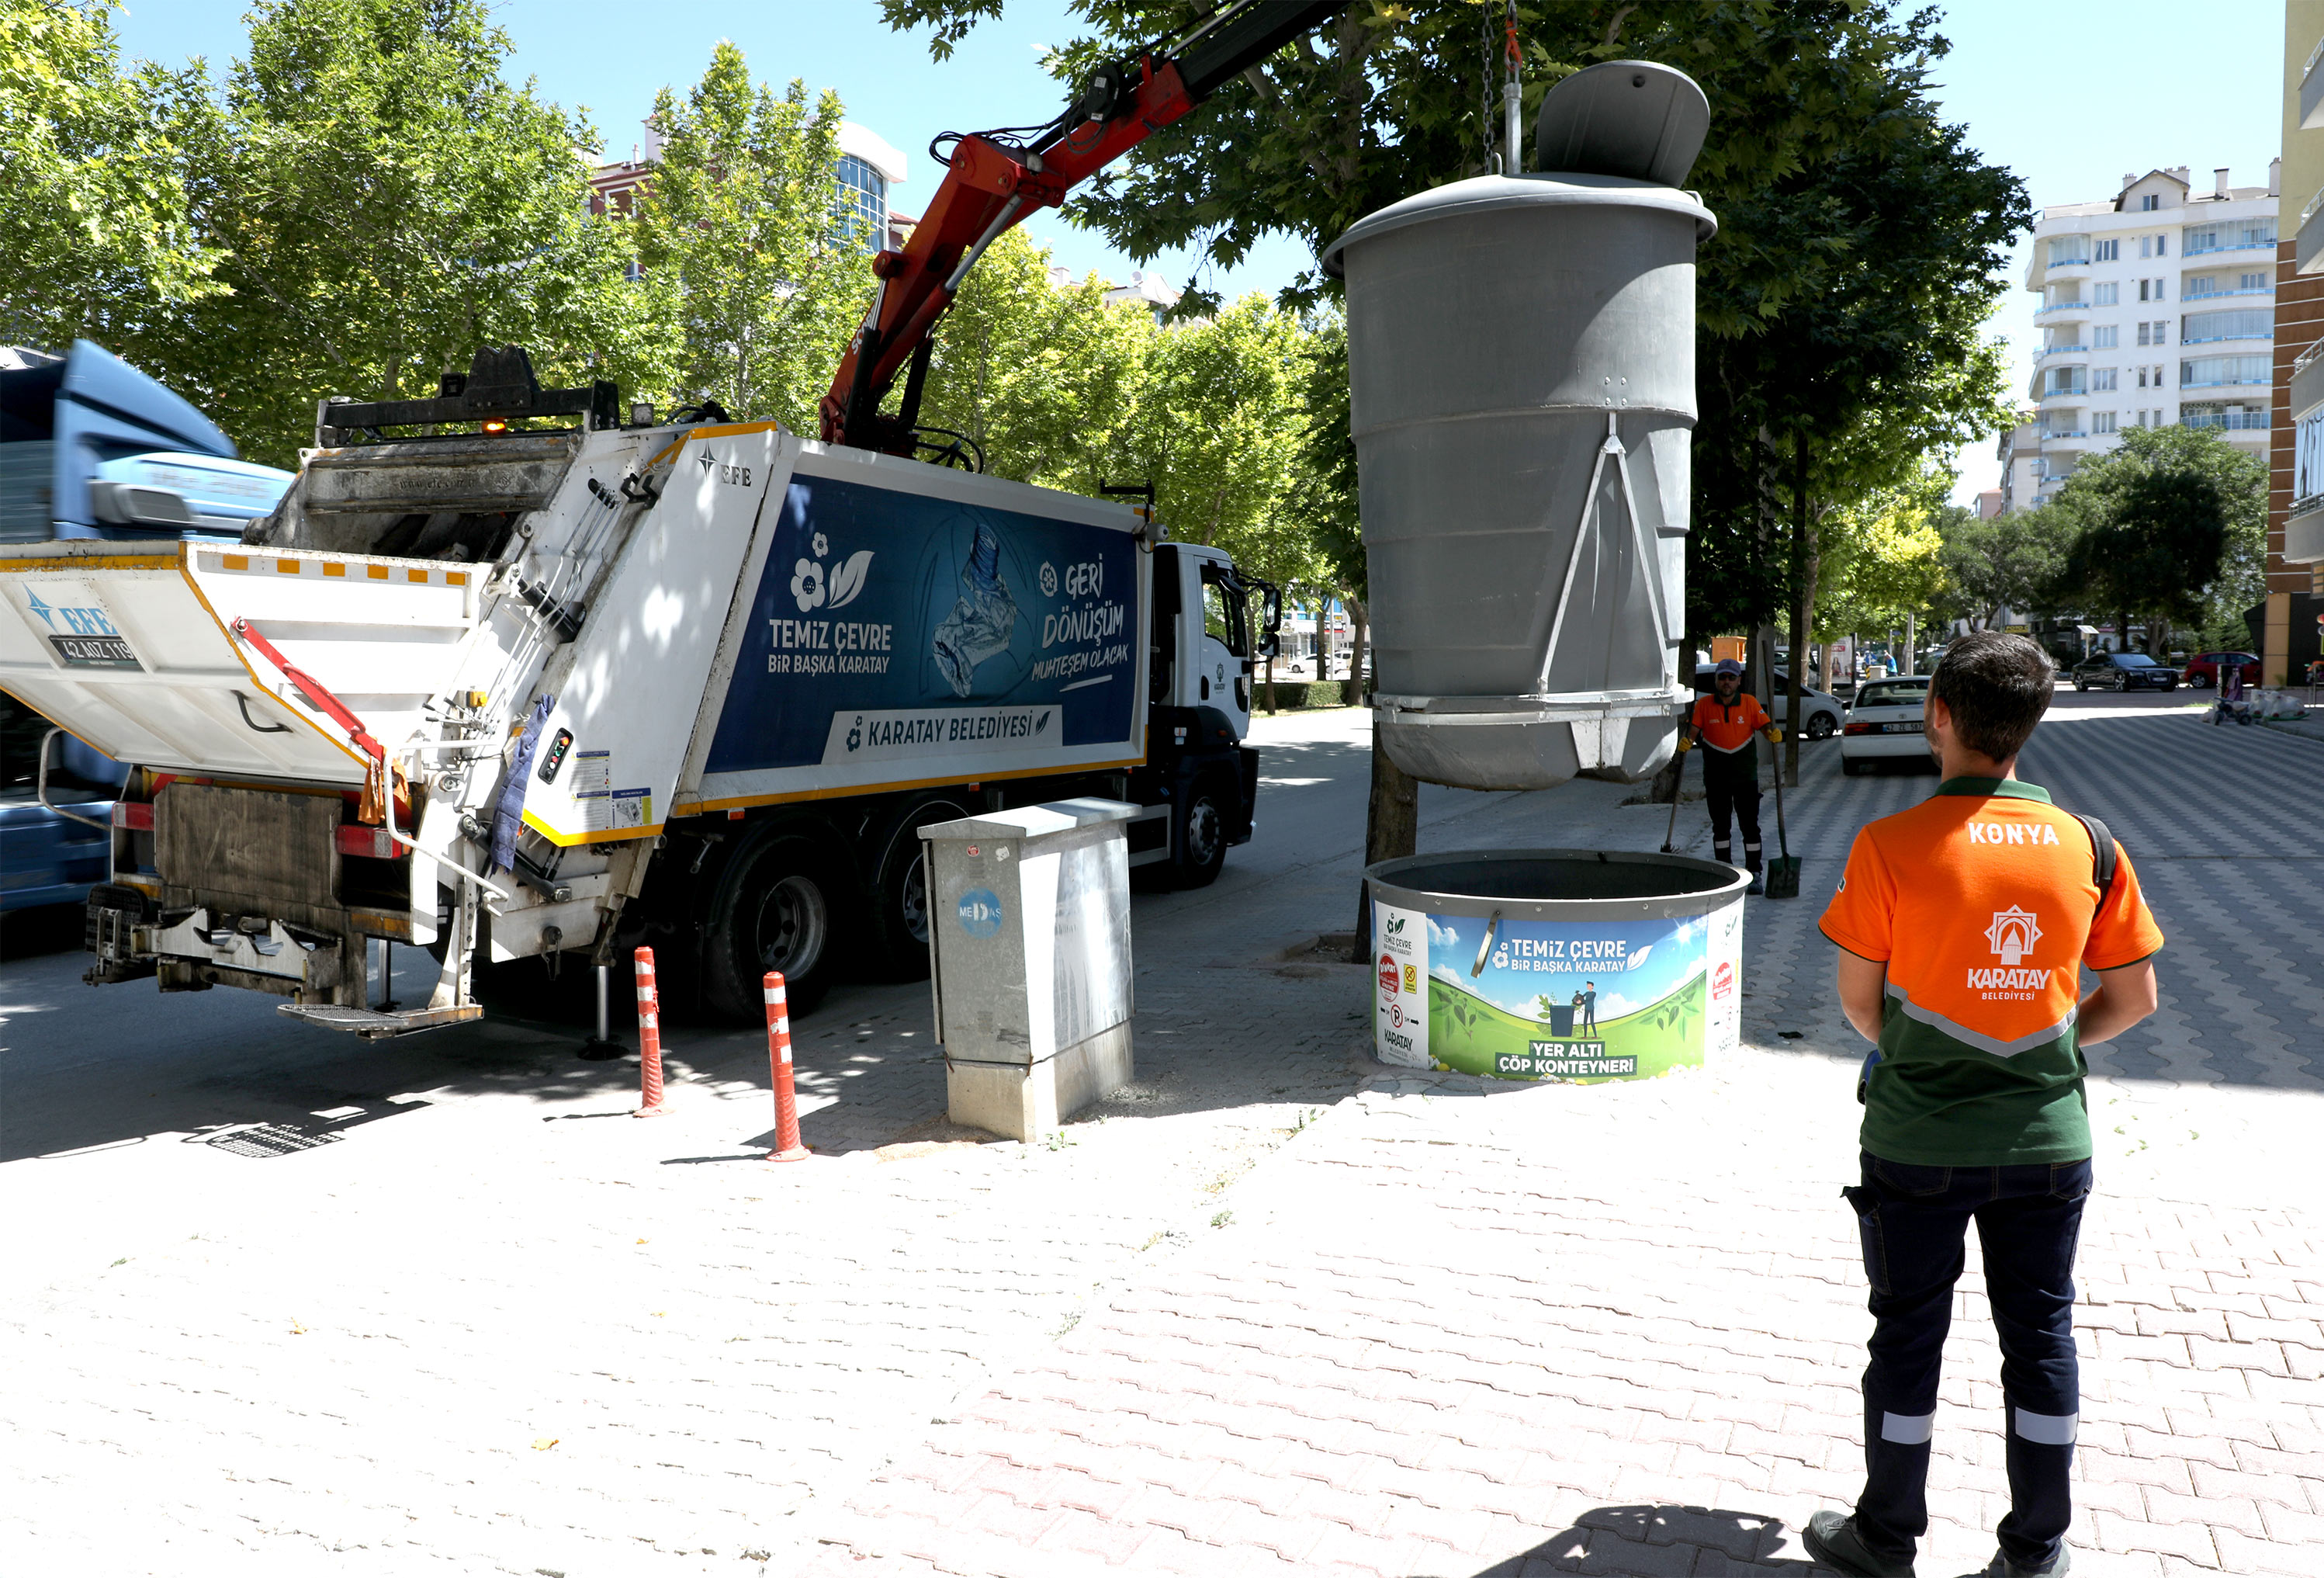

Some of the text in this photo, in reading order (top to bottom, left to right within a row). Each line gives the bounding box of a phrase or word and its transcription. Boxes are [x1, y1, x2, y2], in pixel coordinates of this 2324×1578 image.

[720, 464, 752, 487] EFE
[1065, 553, 1103, 600] GERİ
[58, 608, 119, 634] EFE
[1042, 600, 1124, 649] DÖNÜŞÜM
[834, 622, 892, 655] ÇEVRE
[106, 642, 135, 659] 119
[1031, 643, 1129, 681] MUHTEŞEM OLACAK
[794, 655, 836, 677] BAŞKA
[838, 656, 890, 674] KARATAY
[868, 709, 1033, 746] KARATAY BELEDİYESİ
[1968, 822, 2060, 845] KONYA
[1570, 940, 1626, 962] ÇEVRE
[1533, 960, 1573, 974] BAŞKA
[1575, 961, 1626, 973] KARATAY
[1966, 968, 2051, 990] KARATAY
[1981, 990, 2035, 1001] BELEDİYESİ
[1384, 1028, 1413, 1052] KARATAY
[1533, 1042, 1602, 1057] YER ALTI
[1499, 1055, 1531, 1072] ÇÖP
